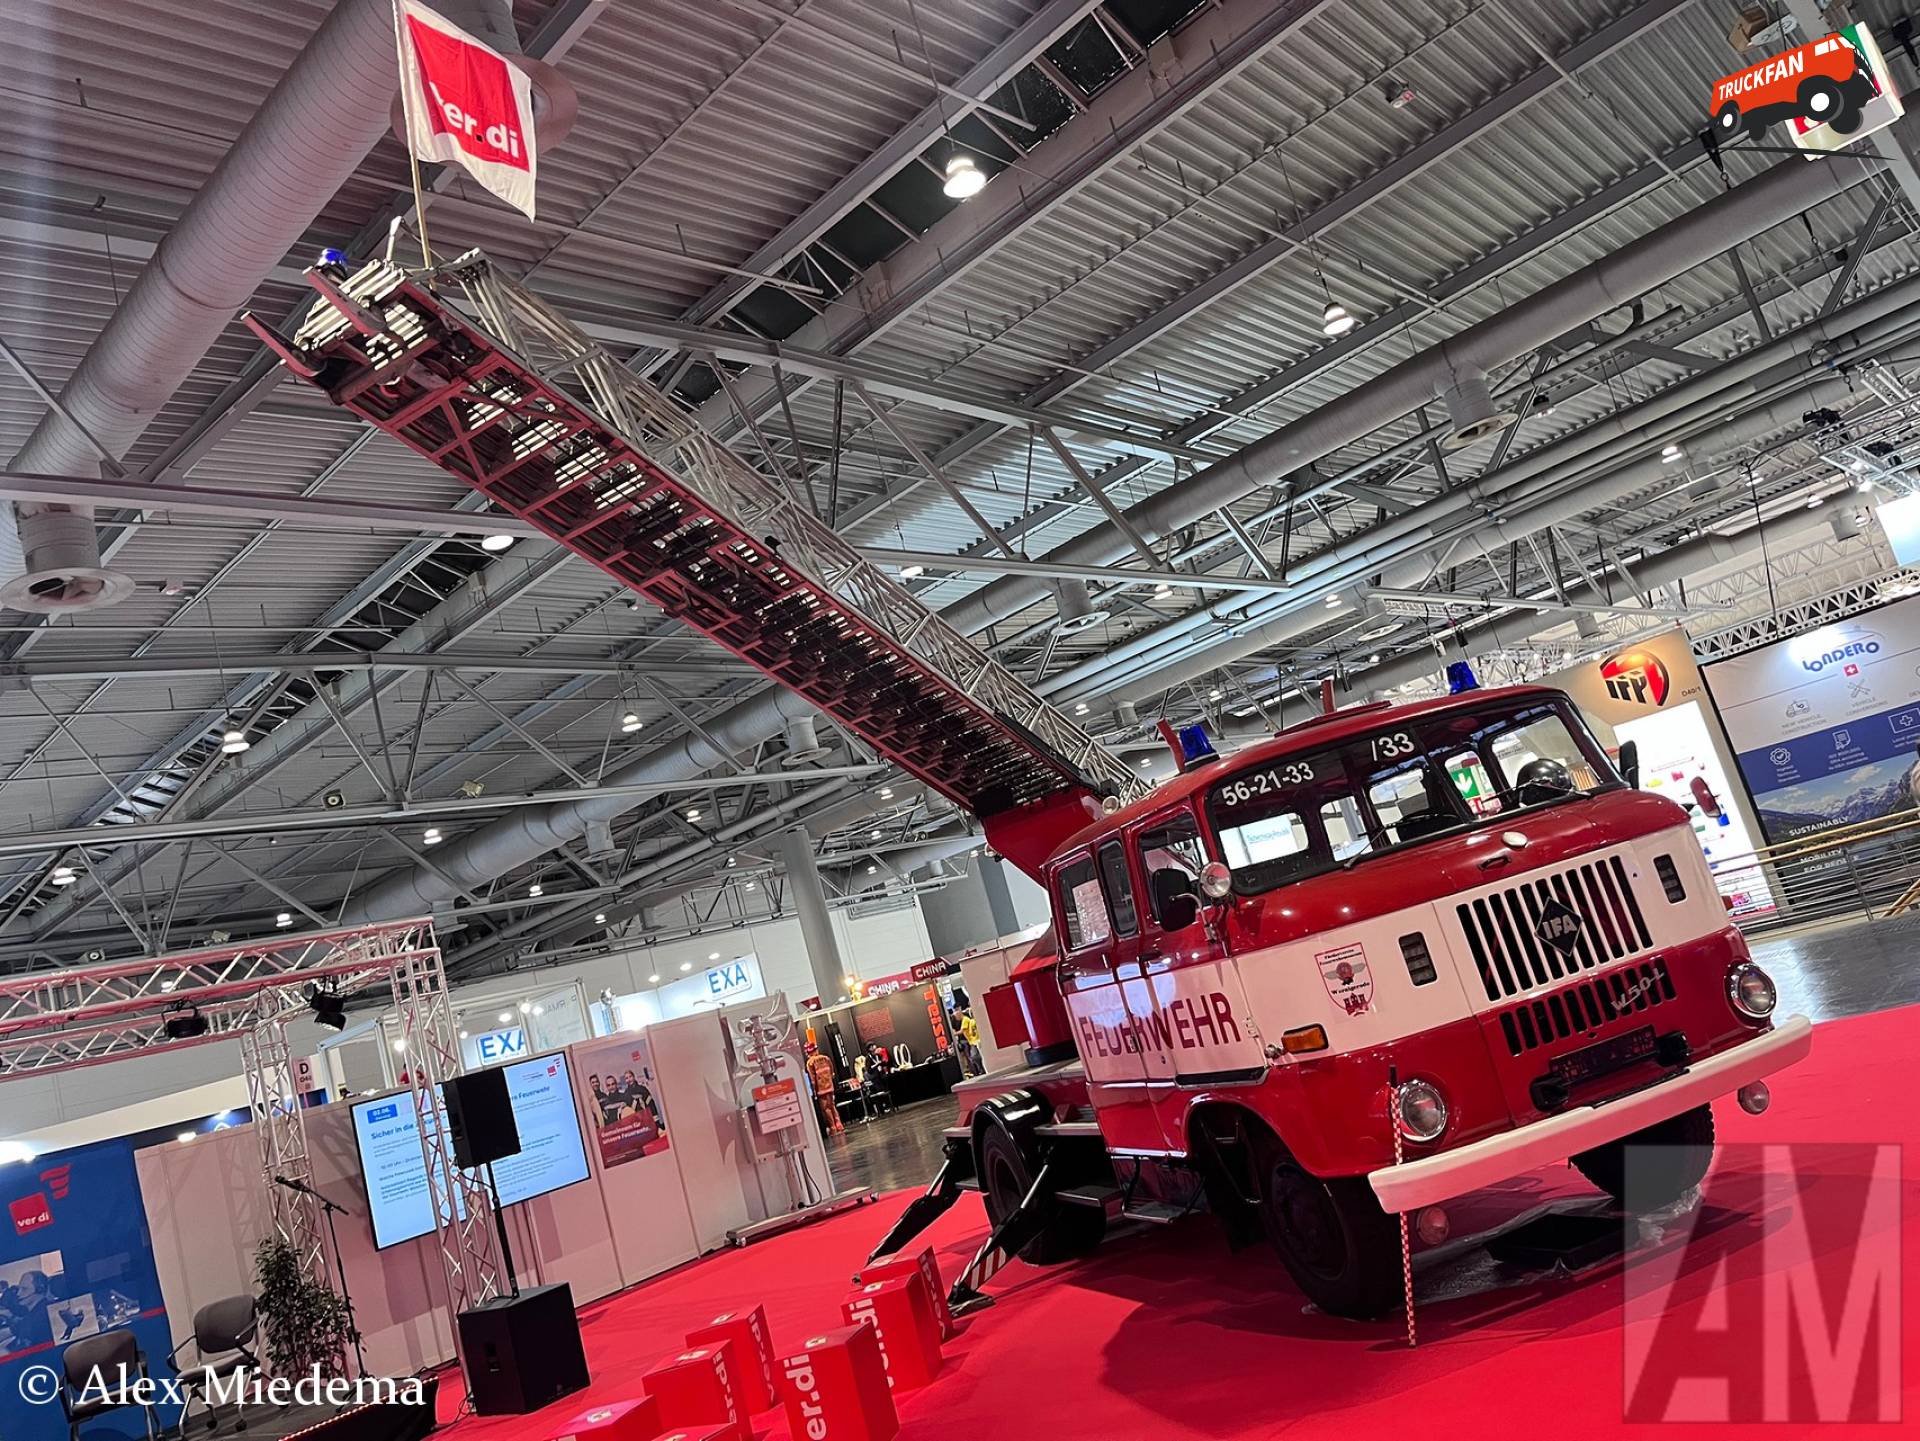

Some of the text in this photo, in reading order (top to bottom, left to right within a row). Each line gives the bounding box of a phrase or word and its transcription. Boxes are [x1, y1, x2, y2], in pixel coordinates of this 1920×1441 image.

[1221, 762, 1315, 806] 56-21-33
[1788, 815, 1850, 837] SUSTAINABLY
[1542, 914, 1579, 940] IFA
[708, 964, 748, 994] EXA
[915, 961, 947, 978] CHINA
[867, 980, 900, 997] CHINA
[1078, 992, 1242, 1058] FEUERWEHR
[712, 1351, 737, 1425] er.di
[783, 1354, 827, 1441] er.di
